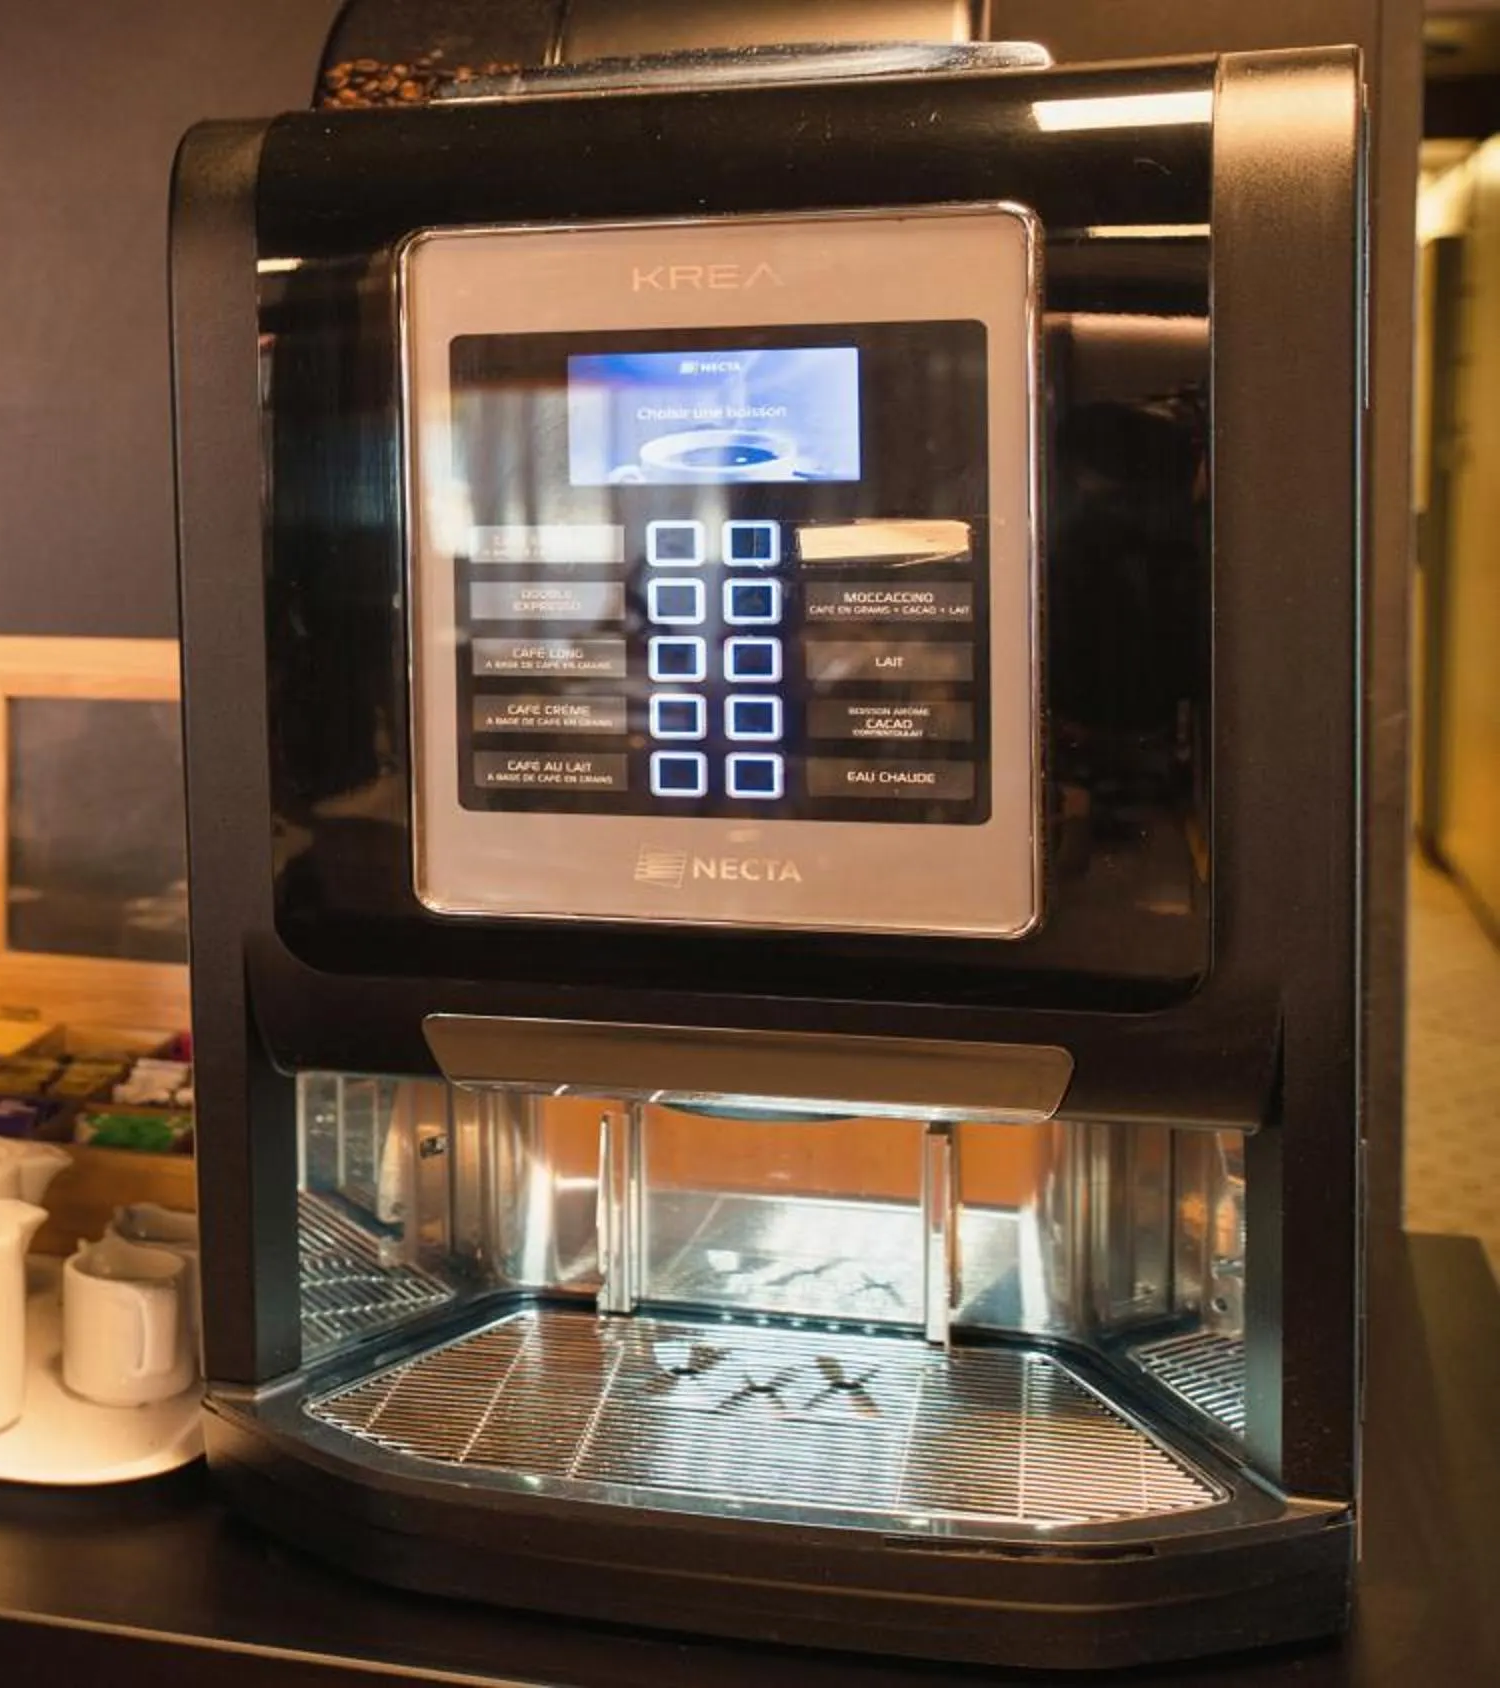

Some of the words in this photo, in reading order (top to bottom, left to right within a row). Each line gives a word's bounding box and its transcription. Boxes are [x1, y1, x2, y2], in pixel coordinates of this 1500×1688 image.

[632, 261, 786, 292] KREA
[700, 361, 742, 374] NECTA
[694, 408, 723, 419] une
[727, 405, 788, 419] boisson
[843, 591, 934, 603] MOCCACCINO
[902, 605, 937, 615] CACAO
[949, 605, 971, 615] LAIT
[875, 656, 905, 667] LAIT
[865, 718, 913, 729] CACAO
[543, 761, 563, 772] AU
[566, 761, 592, 773] LAIT
[846, 771, 875, 783] EAU
[879, 771, 936, 784] CHAUDE
[692, 856, 803, 883] NECTA
